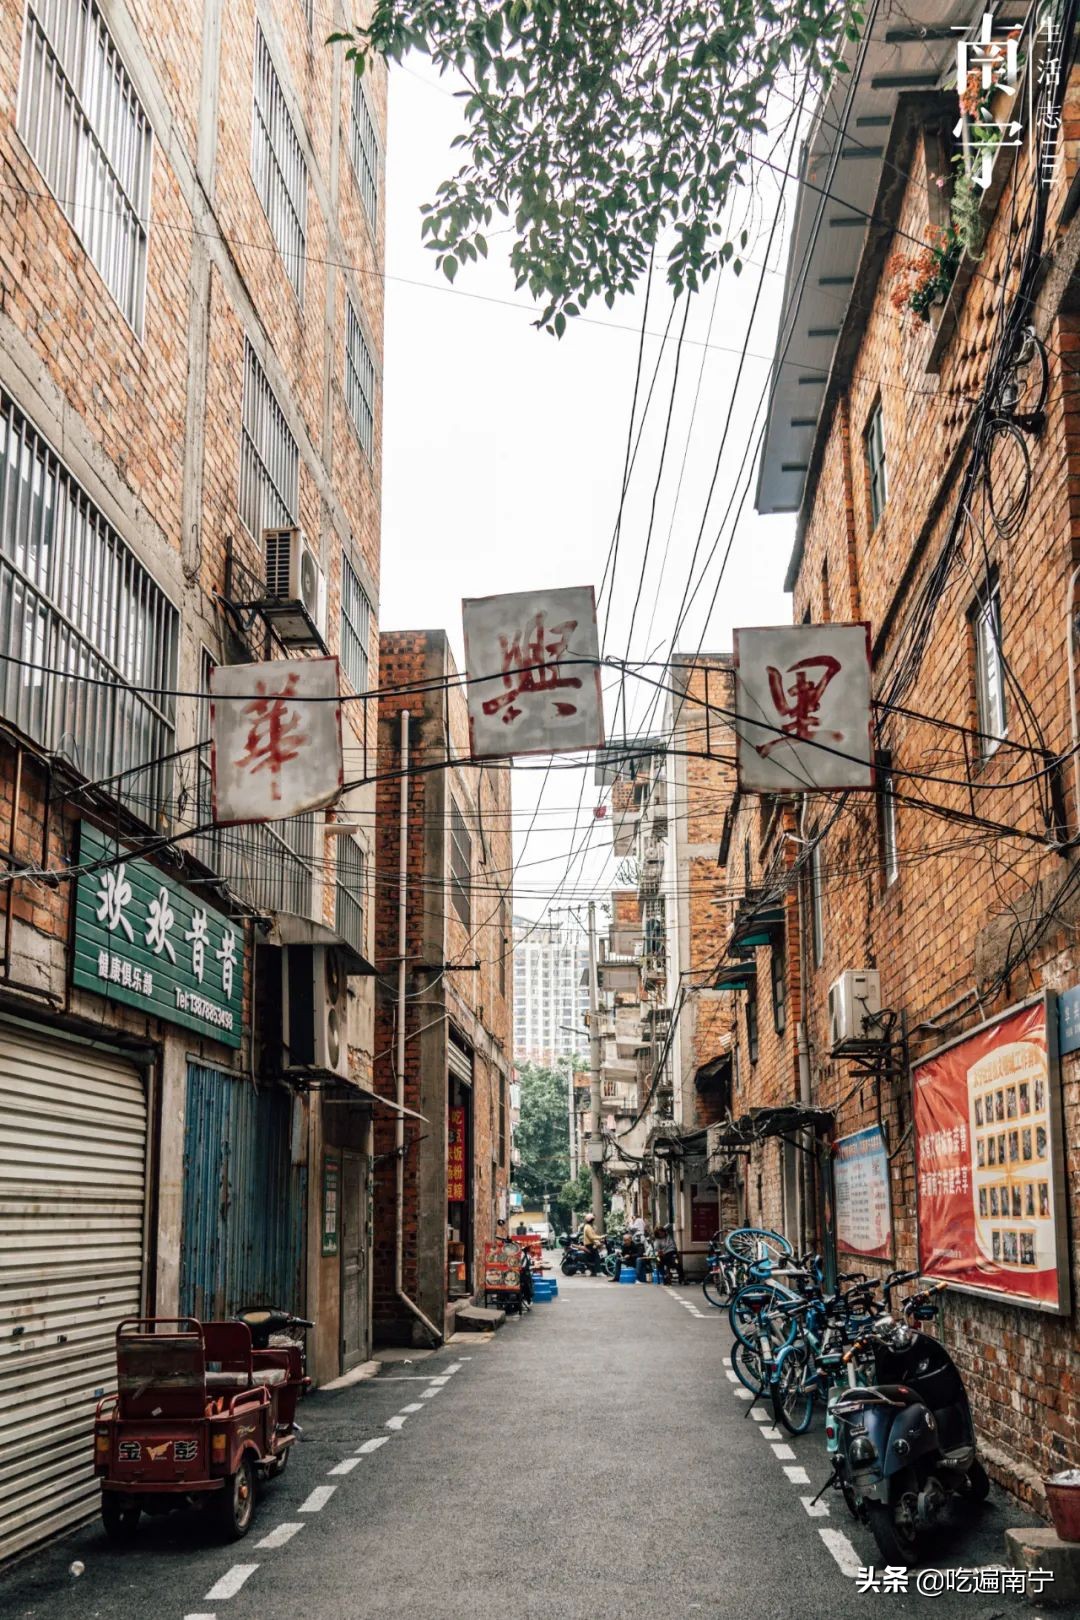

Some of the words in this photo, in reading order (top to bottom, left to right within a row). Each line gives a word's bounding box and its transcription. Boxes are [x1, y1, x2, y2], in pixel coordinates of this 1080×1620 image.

[98, 950, 153, 996] 健康俱乐部
